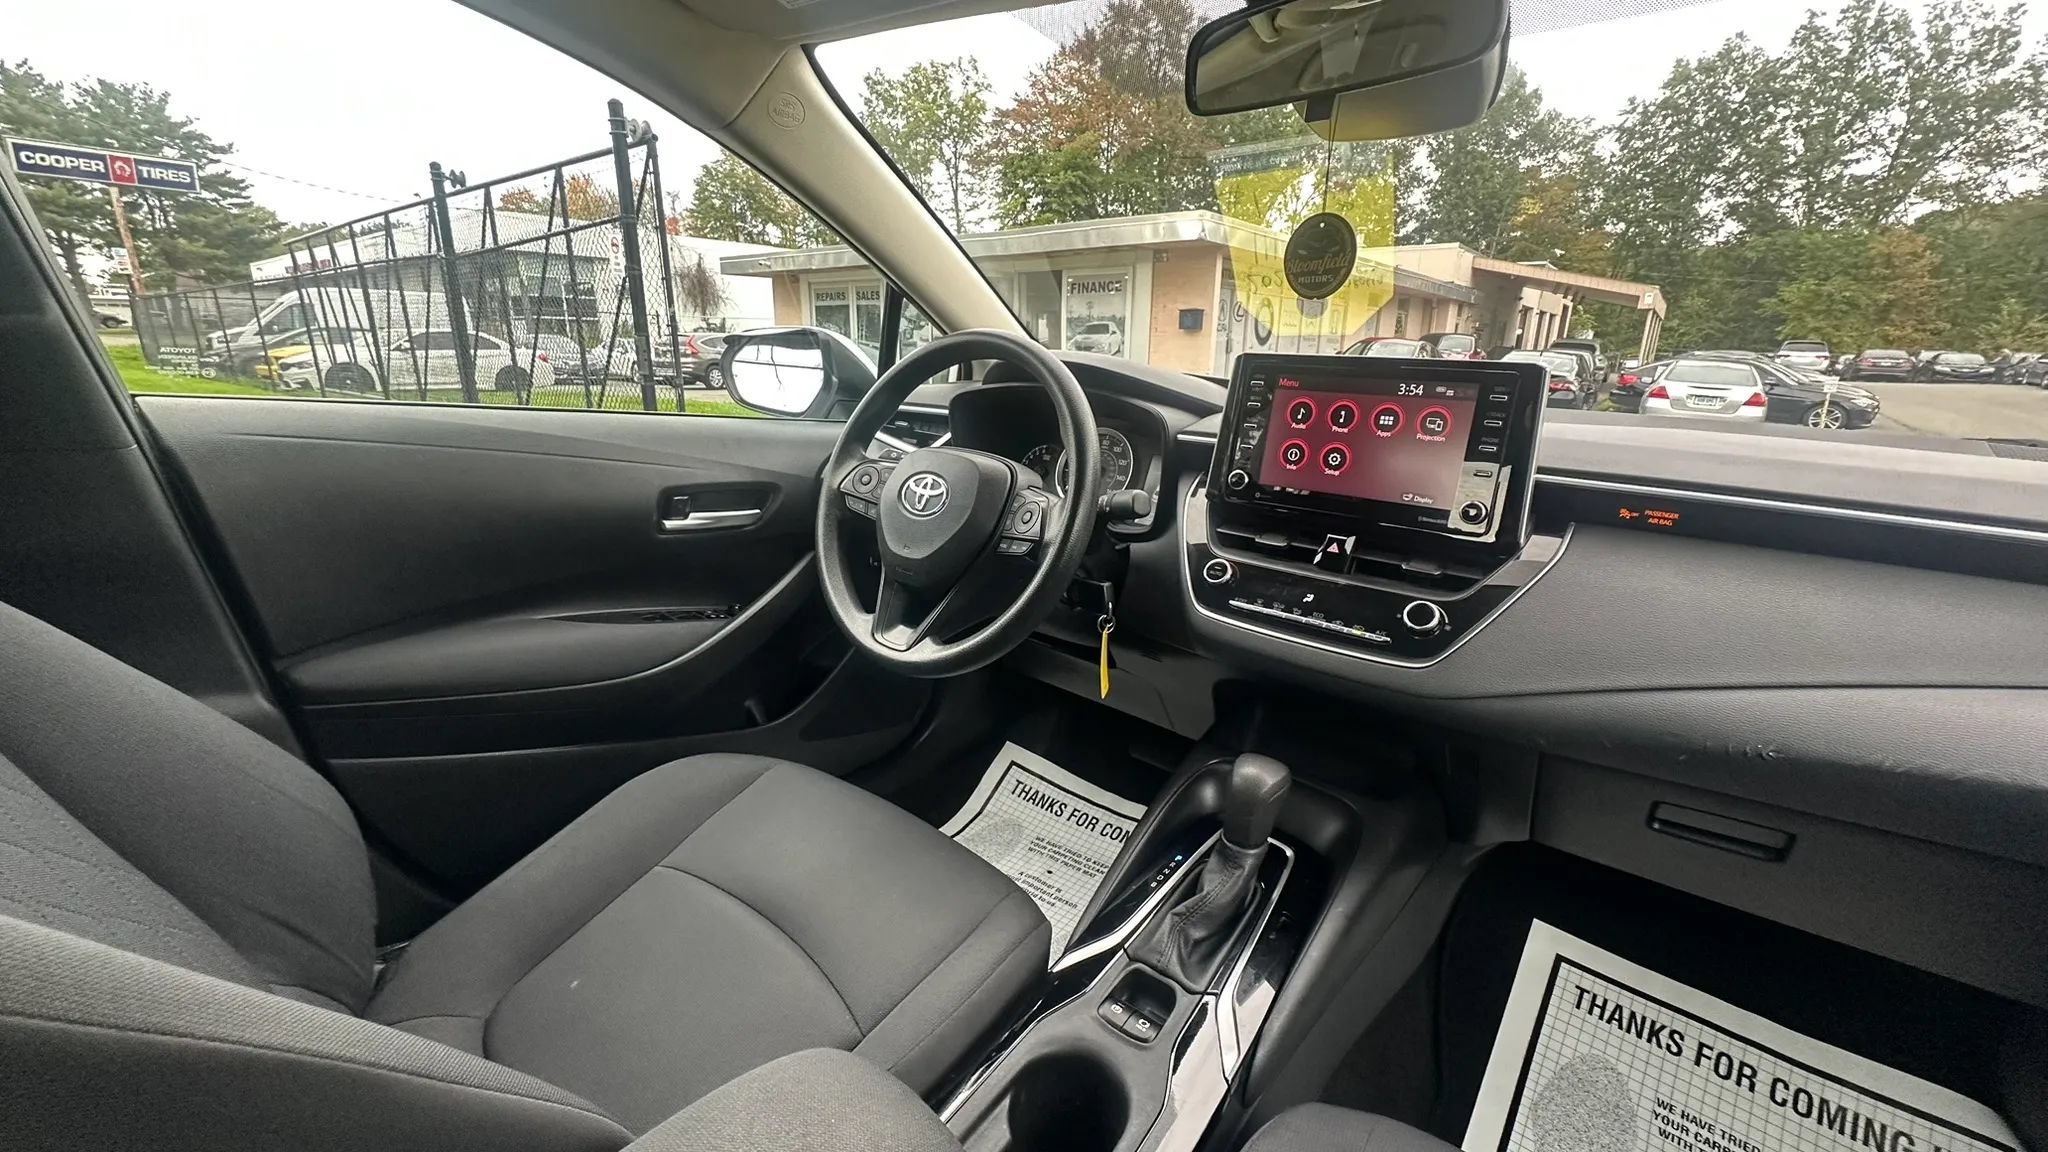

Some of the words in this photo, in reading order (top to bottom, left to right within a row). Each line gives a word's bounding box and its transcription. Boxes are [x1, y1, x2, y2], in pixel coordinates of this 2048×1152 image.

[19, 151, 106, 173] COOPER
[138, 165, 191, 183] TIRES
[1298, 274, 1334, 284] MOTORS
[1070, 280, 1122, 295] FINANCE
[816, 291, 846, 301] REPAIRS
[856, 291, 880, 300] SALES
[1278, 378, 1300, 388] Menu
[1398, 383, 1424, 396] 3:54
[1291, 422, 1307, 430] Audio
[1331, 425, 1349, 433] Phone
[1376, 429, 1392, 437] Apps
[1416, 433, 1446, 443] Projection
[1286, 463, 1297, 471] Info
[1324, 467, 1341, 476] Setup
[1413, 495, 1434, 504] Display
[1644, 509, 1680, 520] PASSENGER
[1011, 779, 1067, 817] THANKS
[1067, 808, 1100, 832] FOR
[1031, 840, 1047, 850] YOUR
[1047, 847, 1083, 866] CARPETING
[1083, 863, 1105, 875] CLEAN
[1046, 840, 1062, 849] HAVE
[1063, 847, 1082, 858] TRIED
[1083, 855, 1092, 863] TO
[1092, 860, 1109, 869] KEEP
[1028, 846, 1044, 856] WITH
[1046, 853, 1060, 863] THIS
[1060, 860, 1082, 872] PAPER
[1082, 869, 1097, 879] MAT
[1025, 873, 1055, 890] customer
[1021, 880, 1054, 898] important
[1053, 895, 1078, 909] person
[1024, 889, 1038, 899] orld
[1575, 985, 1684, 1057] THANKS
[1694, 1040, 1758, 1094] FOR
[1769, 1077, 1915, 1152] COMING
[1653, 1110, 1690, 1136] YOUR
[1656, 1097, 1677, 1115] WE
[1681, 1110, 1716, 1135] HAVE
[1720, 1128, 1761, 1152] TRIED
[1658, 1127, 1693, 1152] WITH
